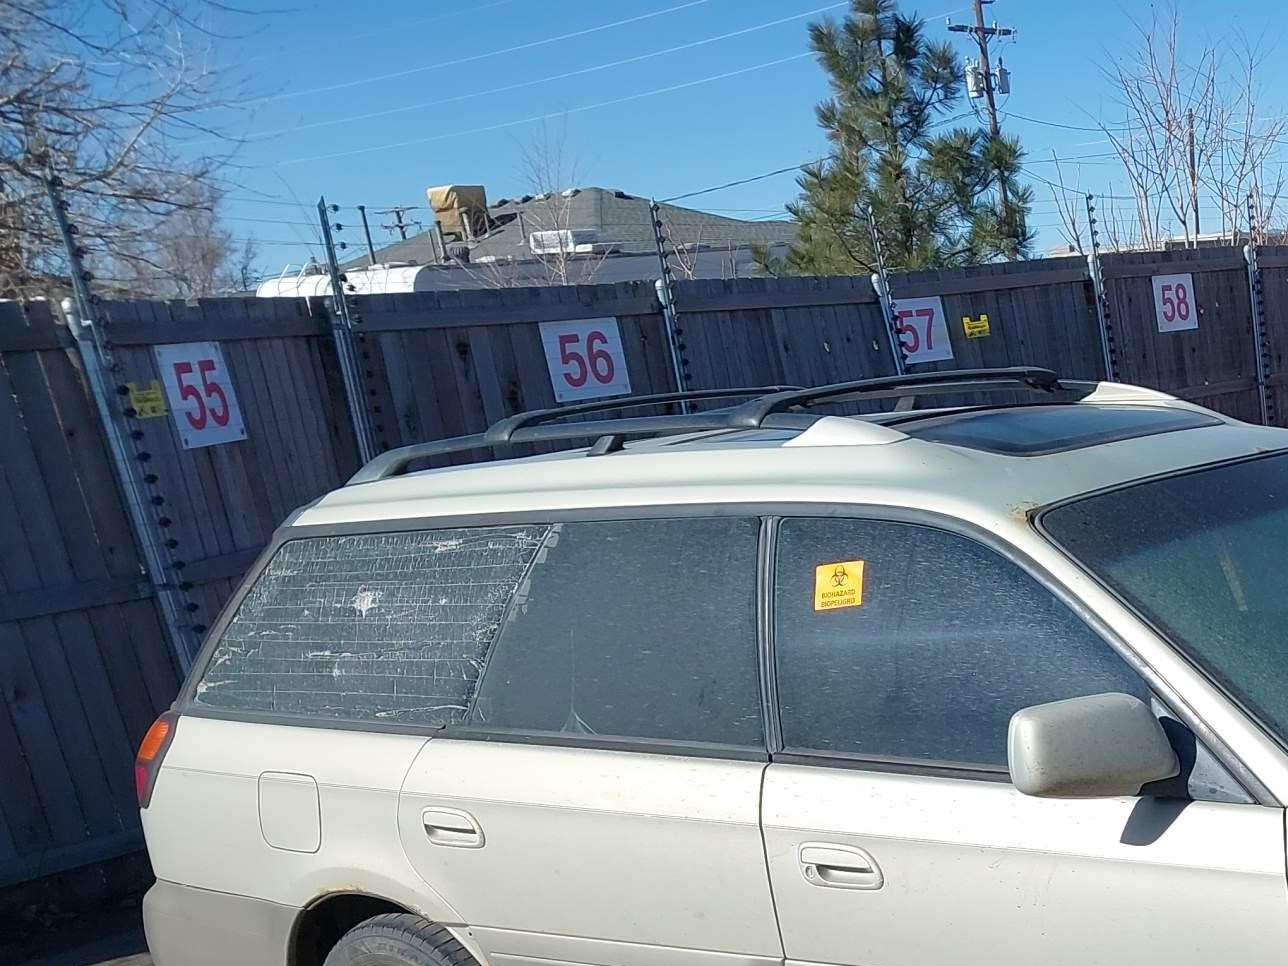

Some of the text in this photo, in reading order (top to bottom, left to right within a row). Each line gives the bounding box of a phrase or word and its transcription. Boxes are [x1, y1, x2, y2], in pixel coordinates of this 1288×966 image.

[1161, 283, 1190, 322] 58
[897, 308, 934, 353] 57
[558, 330, 615, 387] 56
[173, 359, 230, 430] 55
[821, 589, 856, 599] BIOHAZARD
